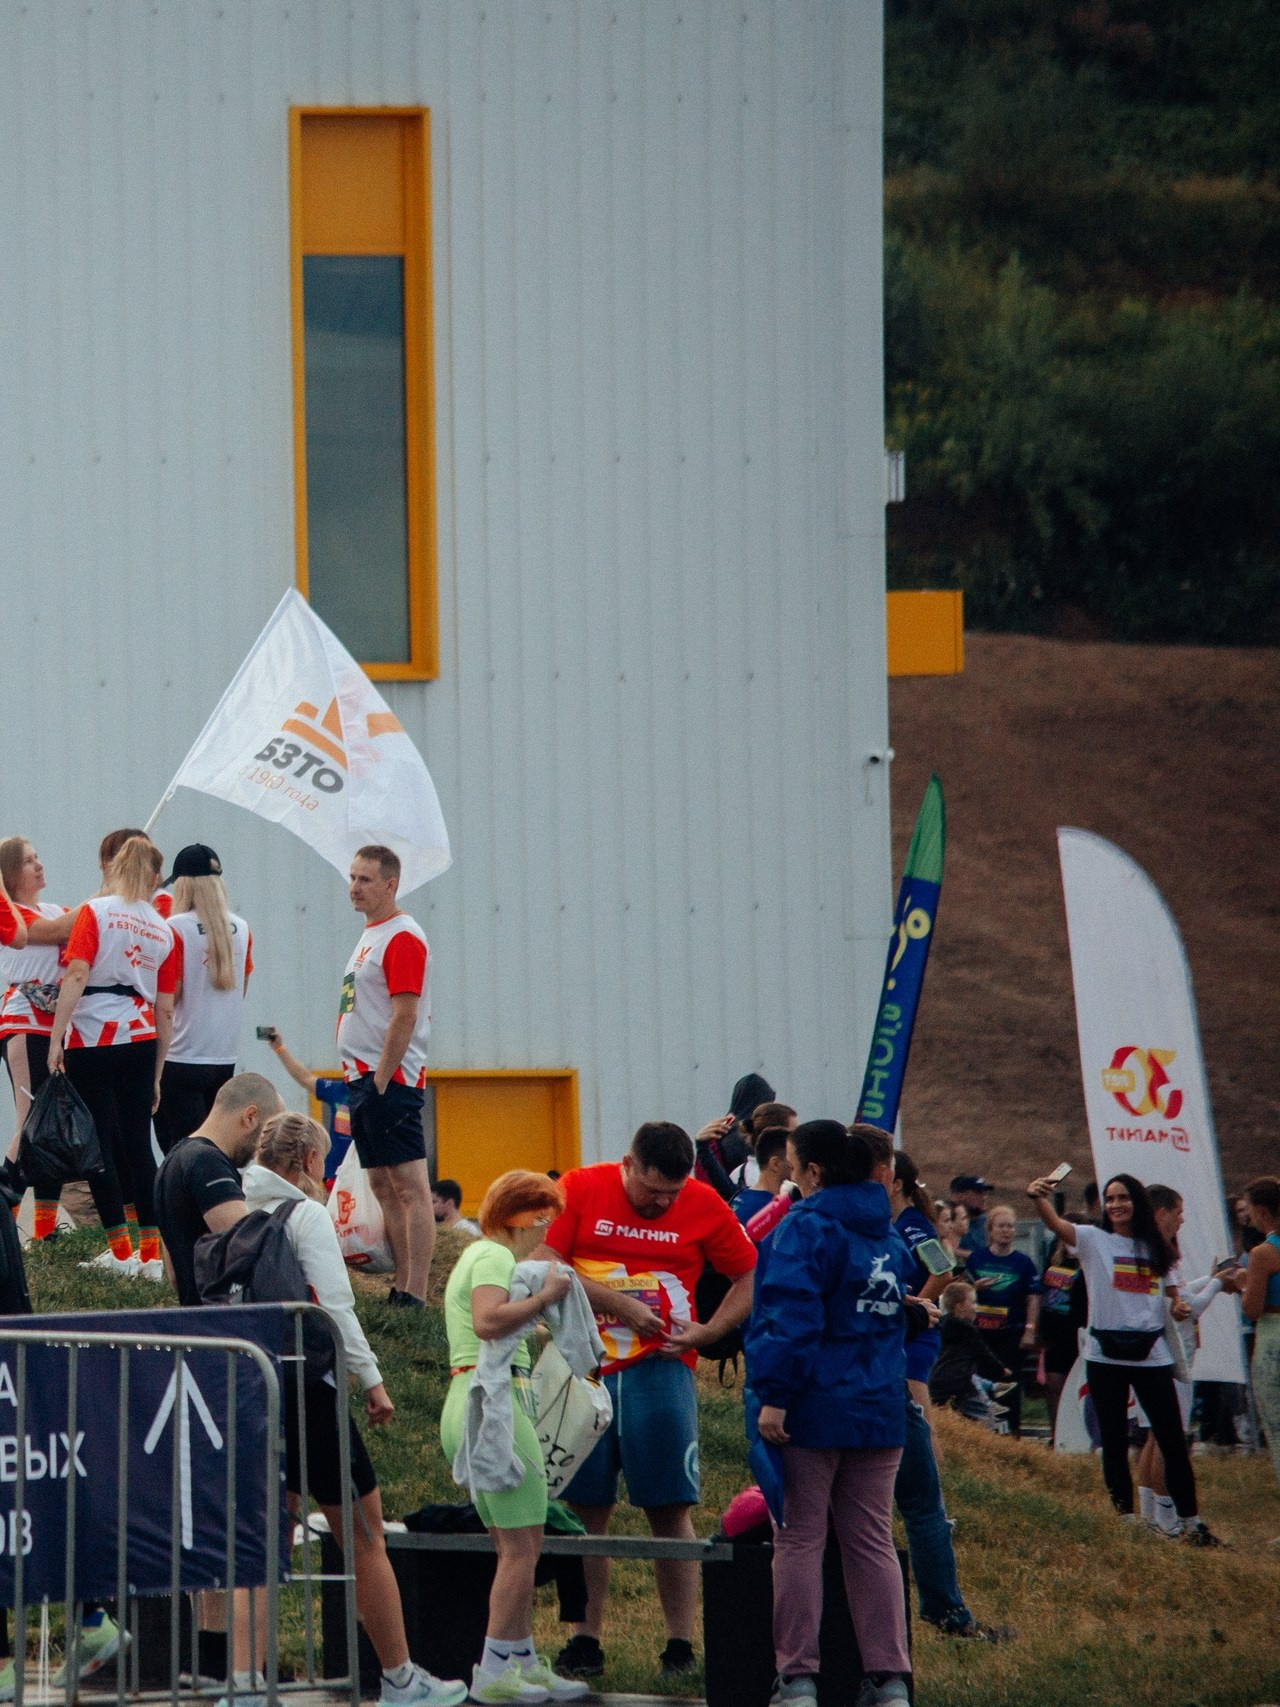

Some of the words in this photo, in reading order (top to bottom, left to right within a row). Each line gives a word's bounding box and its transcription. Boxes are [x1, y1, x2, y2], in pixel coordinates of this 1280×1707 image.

[253, 737, 344, 794] БЗТО
[283, 785, 320, 811] года
[117, 921, 139, 935] БЗТО
[616, 1225, 679, 1244] МАГНИТ
